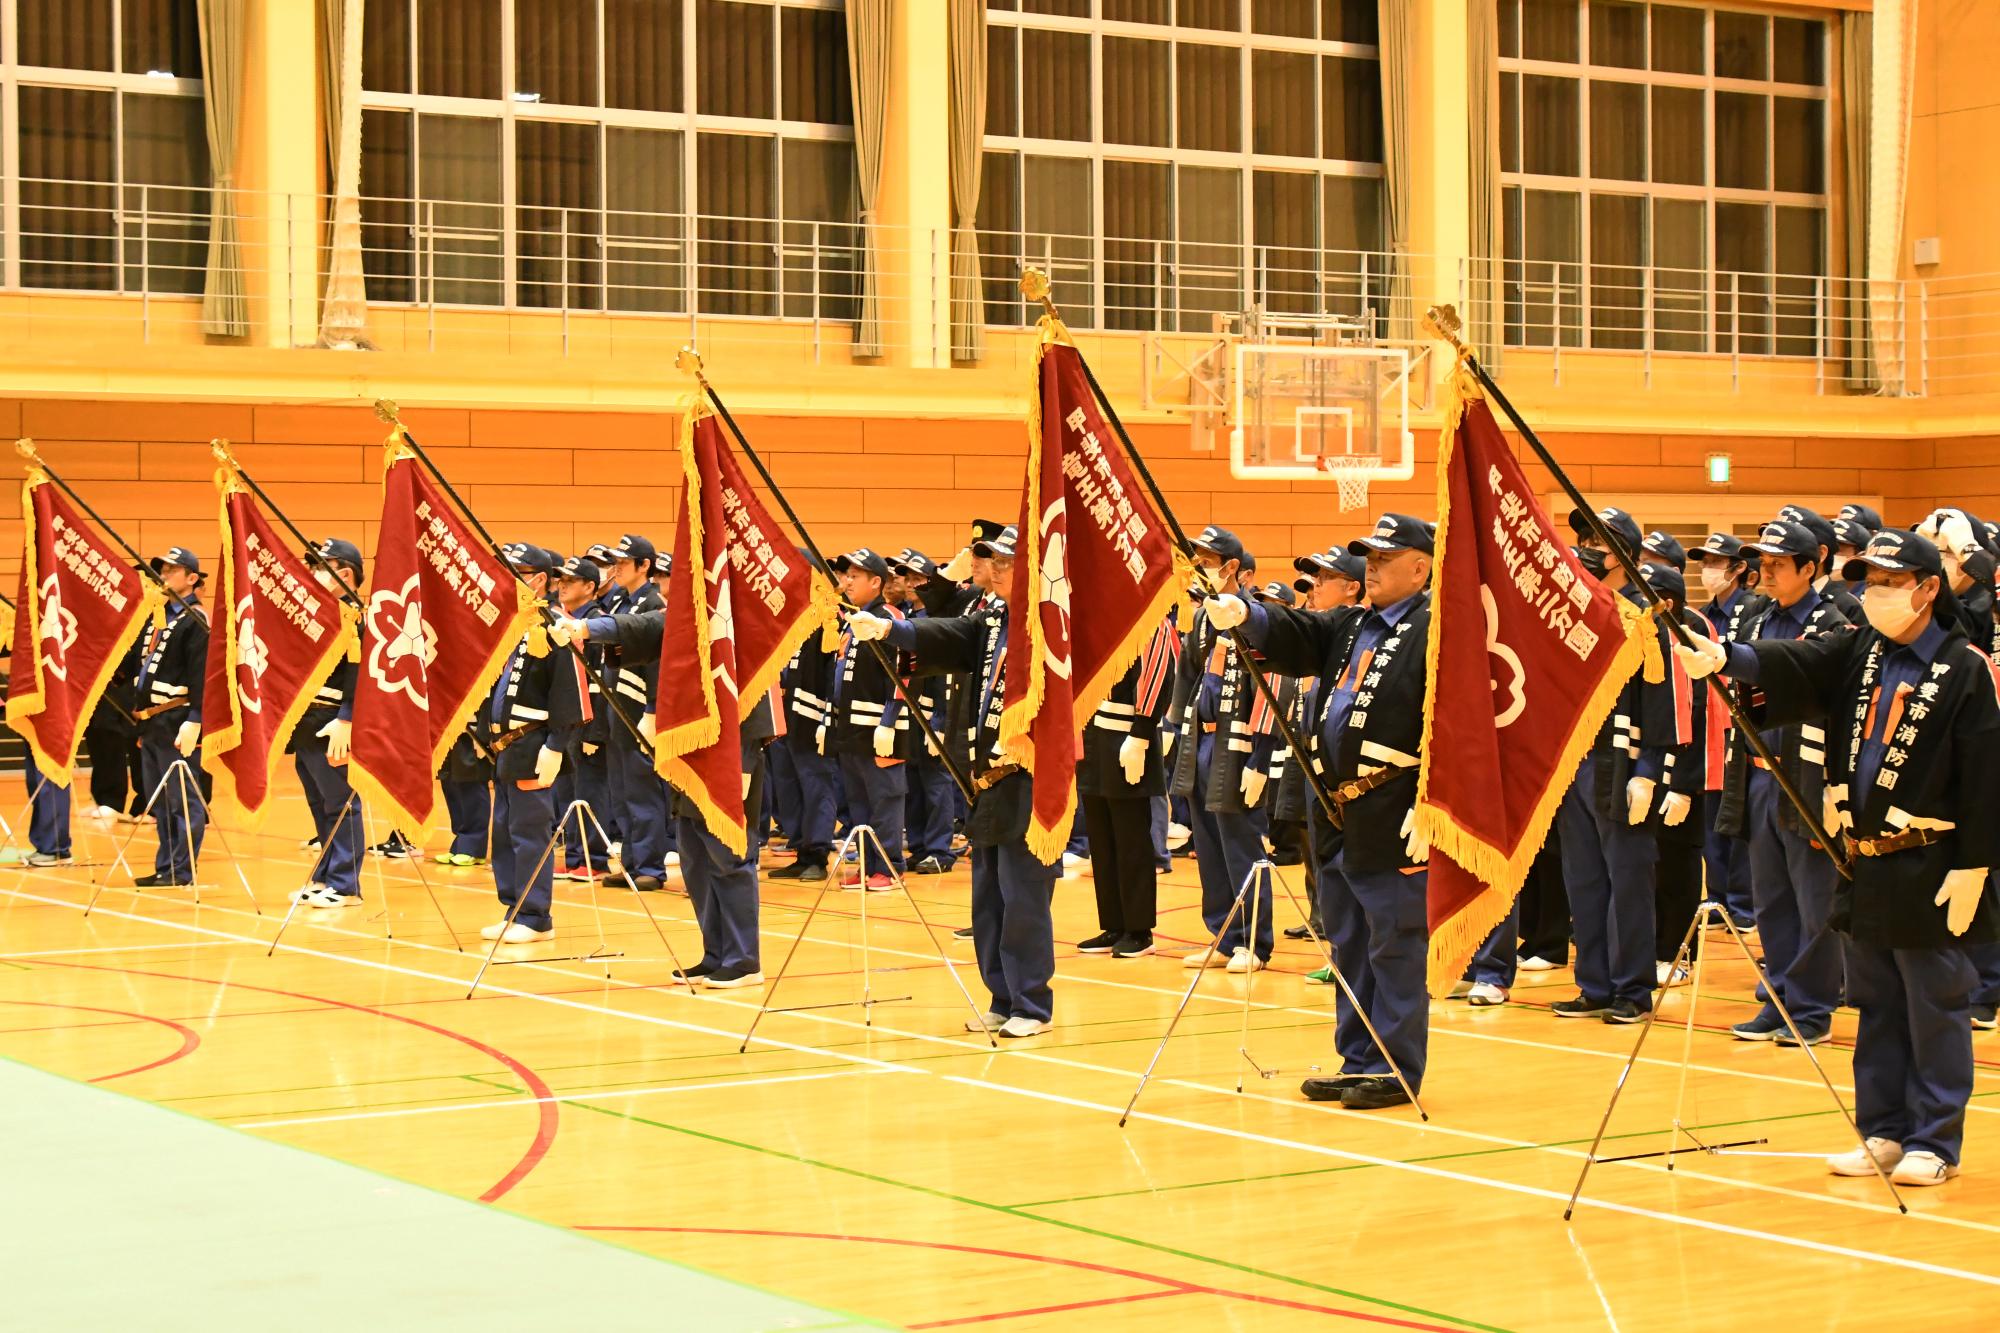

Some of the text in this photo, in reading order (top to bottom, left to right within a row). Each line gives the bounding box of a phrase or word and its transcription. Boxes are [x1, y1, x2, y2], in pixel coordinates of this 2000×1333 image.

[720, 471, 790, 583] 斐市消防團
[1065, 407, 1148, 544] 甲斐市消防團
[1488, 464, 1593, 614] 甲斐市消防團
[984, 664, 1006, 730] 消防團
[1876, 662, 1951, 791] 甲斐市消防團
